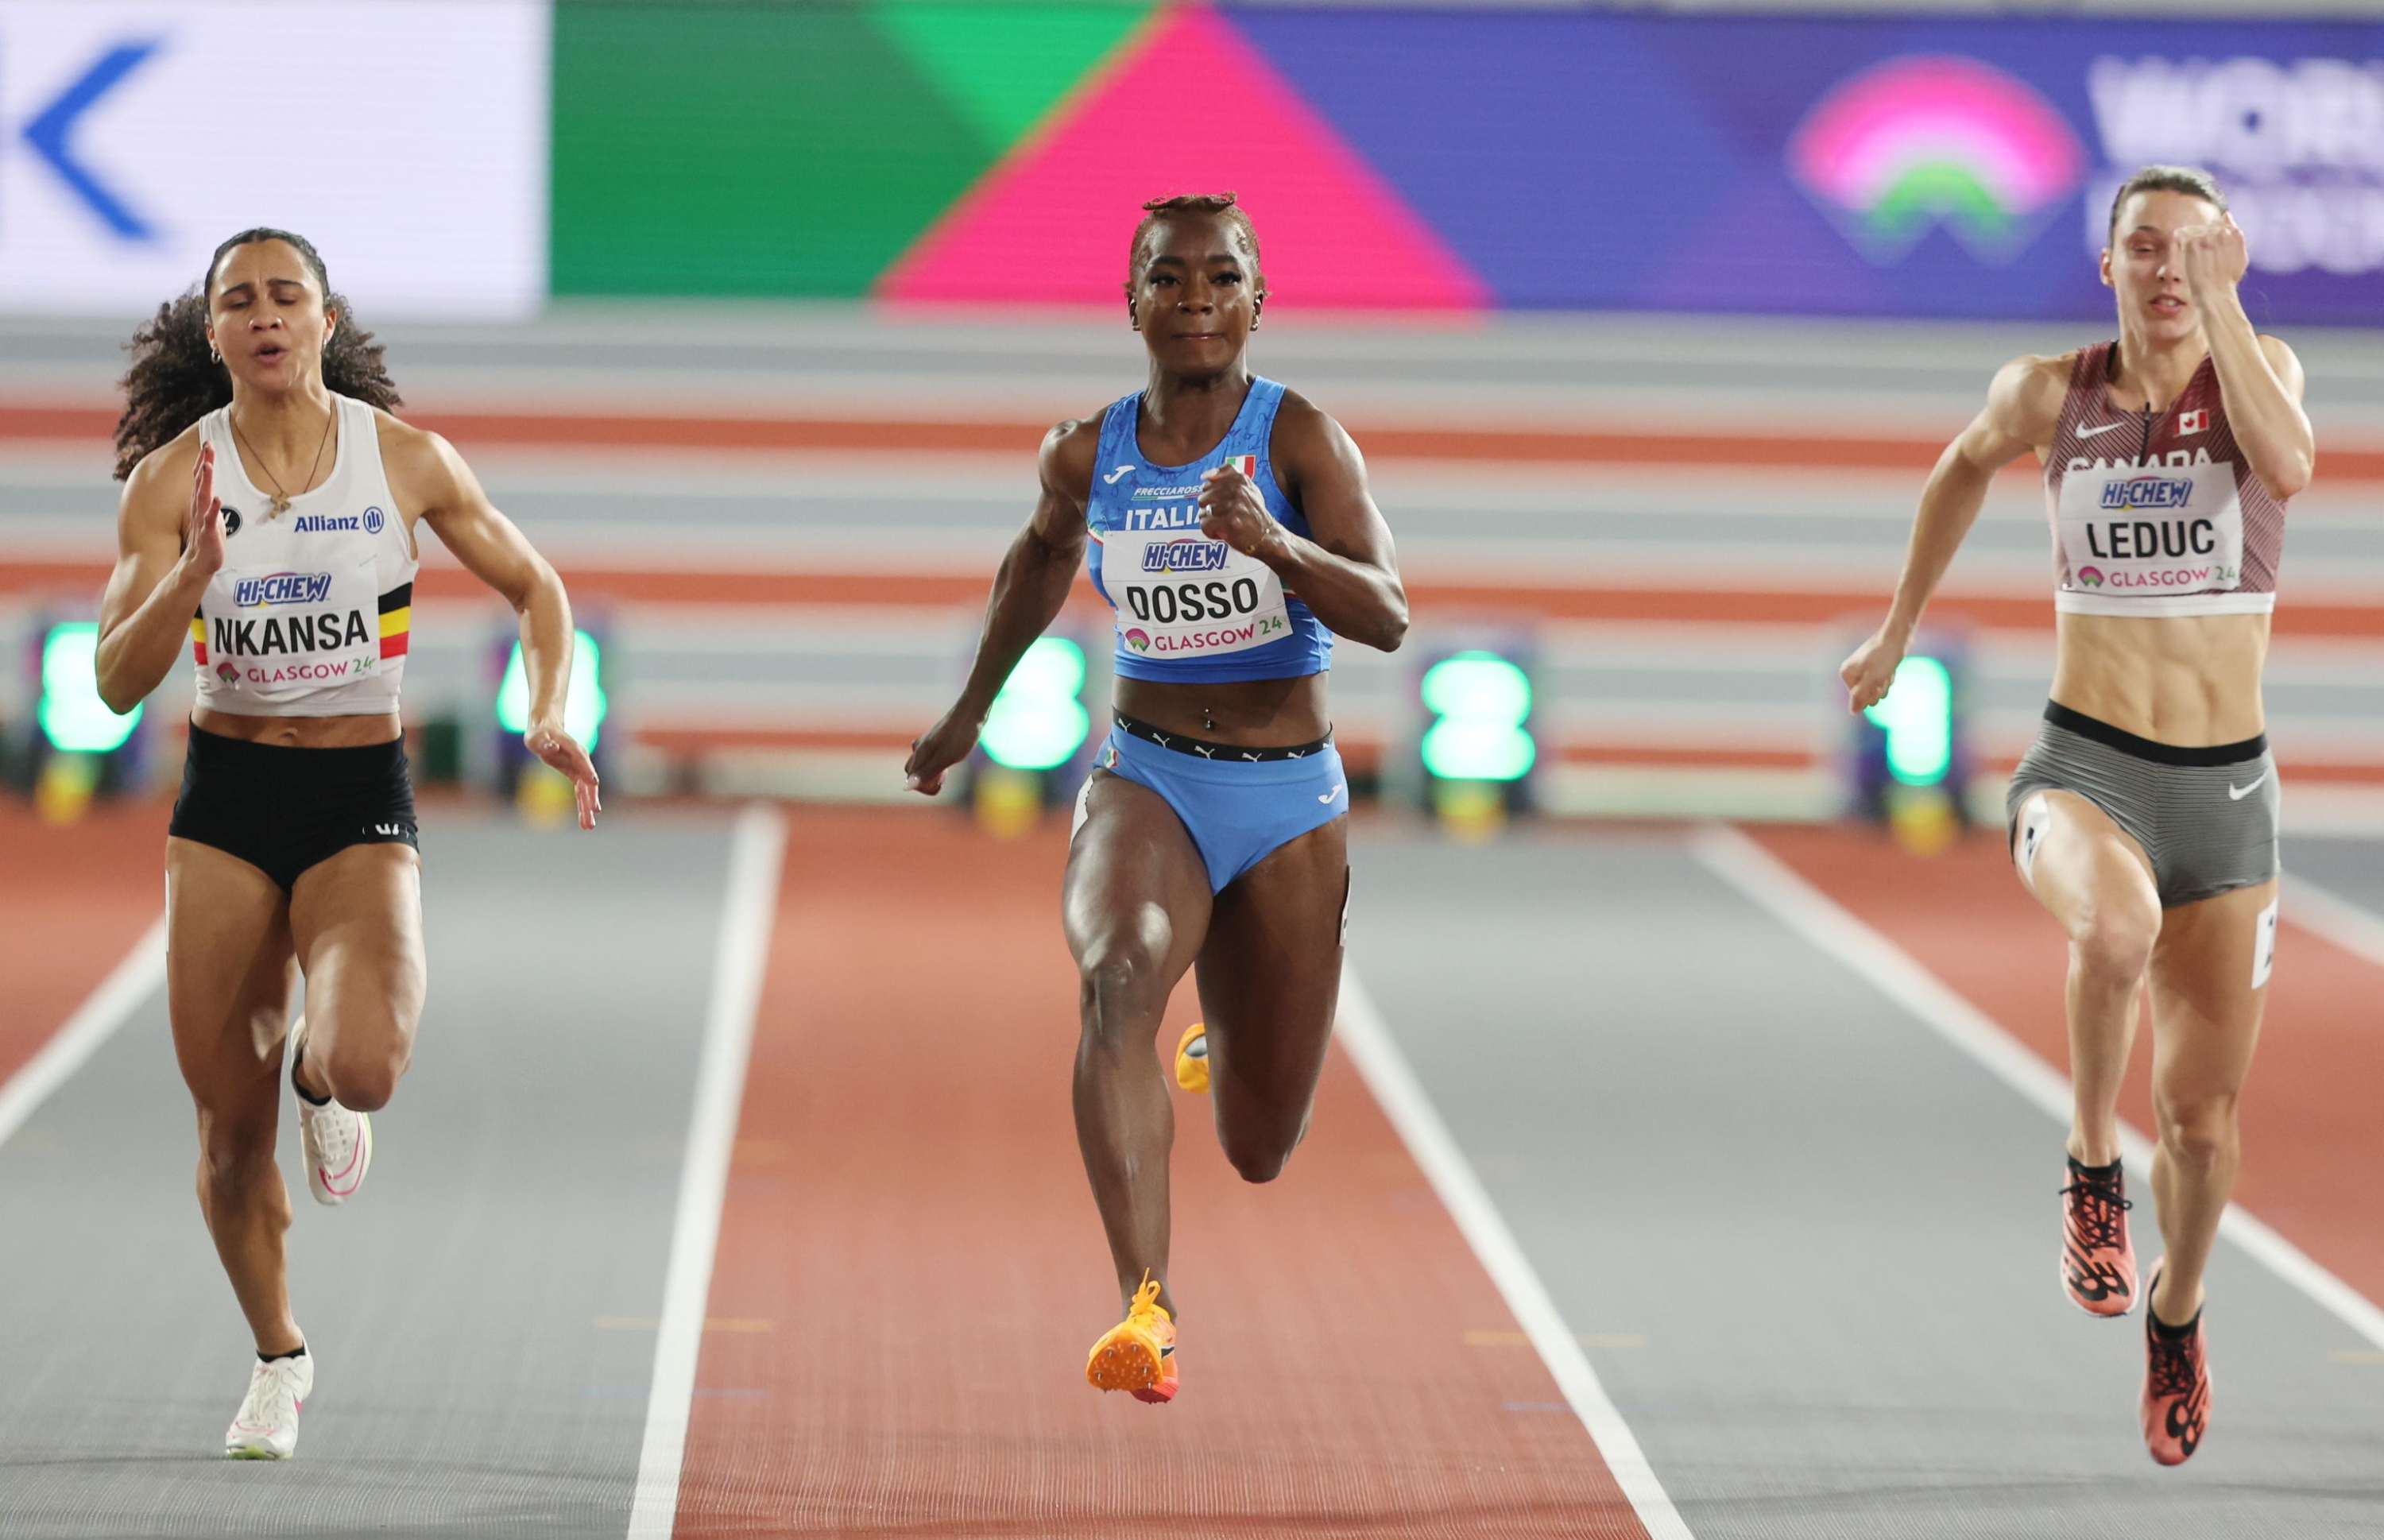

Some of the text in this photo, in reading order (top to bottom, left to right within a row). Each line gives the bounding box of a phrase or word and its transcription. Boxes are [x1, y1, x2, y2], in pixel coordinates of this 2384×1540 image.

[1134, 485, 1204, 496] FRECCIAROSS
[2099, 478, 2193, 509] HI-CHEW
[294, 515, 359, 533] Allianz
[2086, 519, 2215, 559] LEDUC
[1142, 541, 1229, 572] HI-CHEW
[234, 572, 331, 607] HI-CHEW
[2110, 565, 2235, 587] GLASGOW 24
[1126, 578, 1258, 624] DOSSO
[215, 609, 369, 656] NKANSA
[1155, 616, 1283, 652] GLASGOW 24
[247, 656, 372, 683] GLASGOW 24
